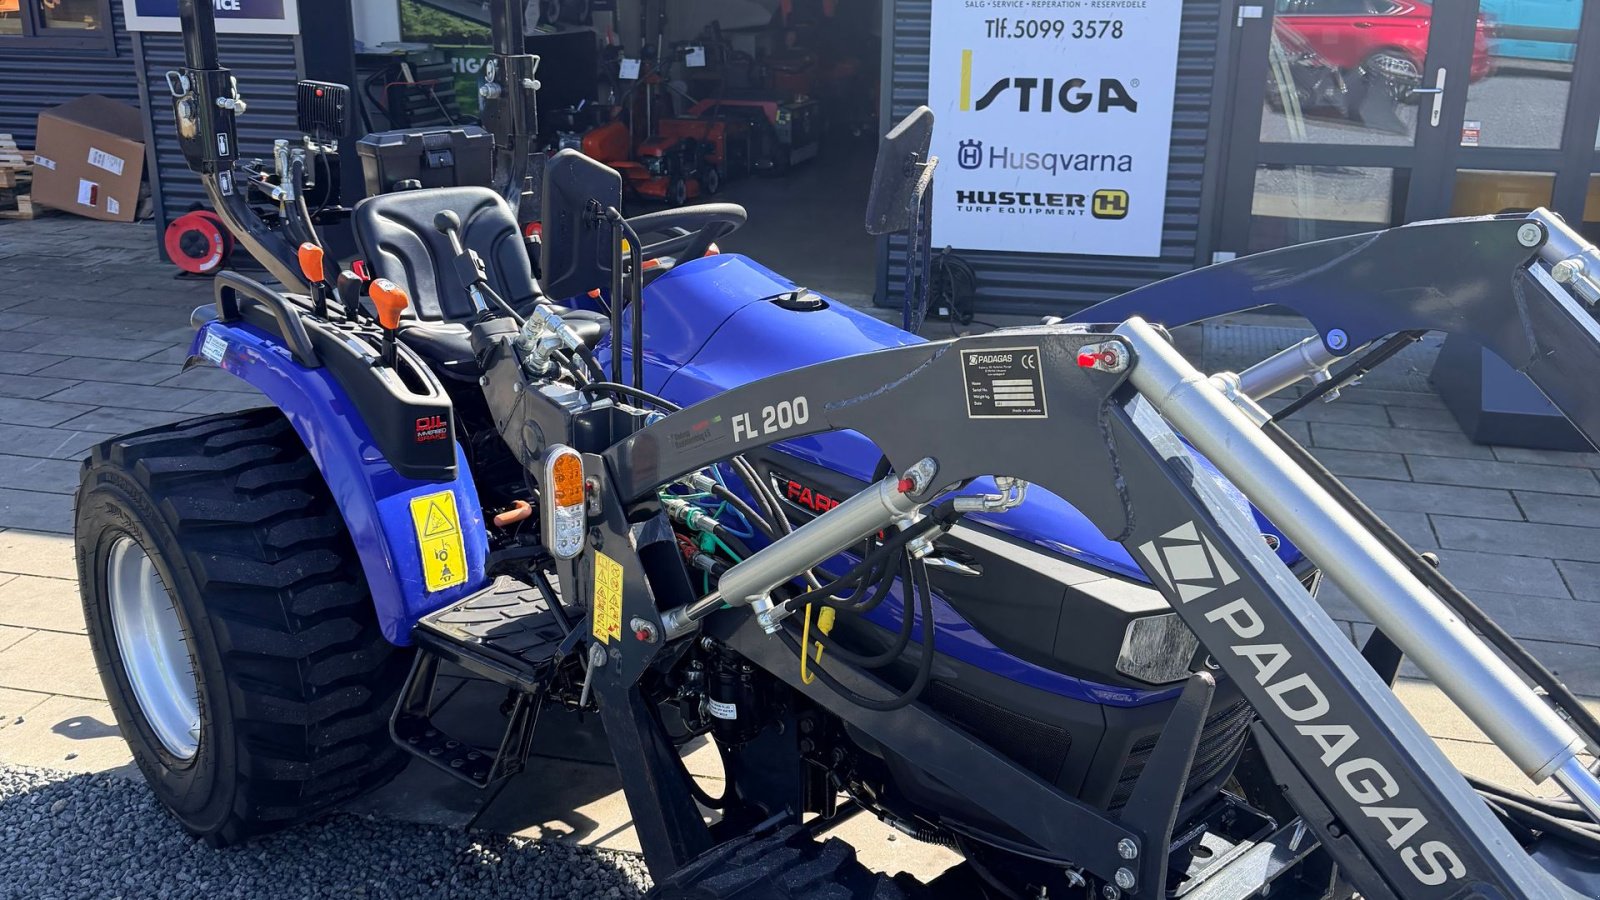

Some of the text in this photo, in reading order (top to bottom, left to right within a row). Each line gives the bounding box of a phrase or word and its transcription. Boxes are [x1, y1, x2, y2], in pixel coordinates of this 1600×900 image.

[213, 0, 240, 10] ICE
[965, 0, 1146, 8] SALG SERVICE REPERATION RESERVEDELE
[1071, 20, 1123, 39] 3578
[975, 77, 1137, 113] STIGA
[989, 146, 1132, 176] Husqvarna
[956, 190, 1085, 208] HUSTLER
[957, 205, 1085, 216] TURF EQUIPMENT
[978, 354, 1013, 364] PADAGAS
[416, 415, 447, 431] OIL
[731, 412, 759, 443] FL
[761, 396, 810, 435] 200
[1204, 597, 1467, 886] PADAGAS
